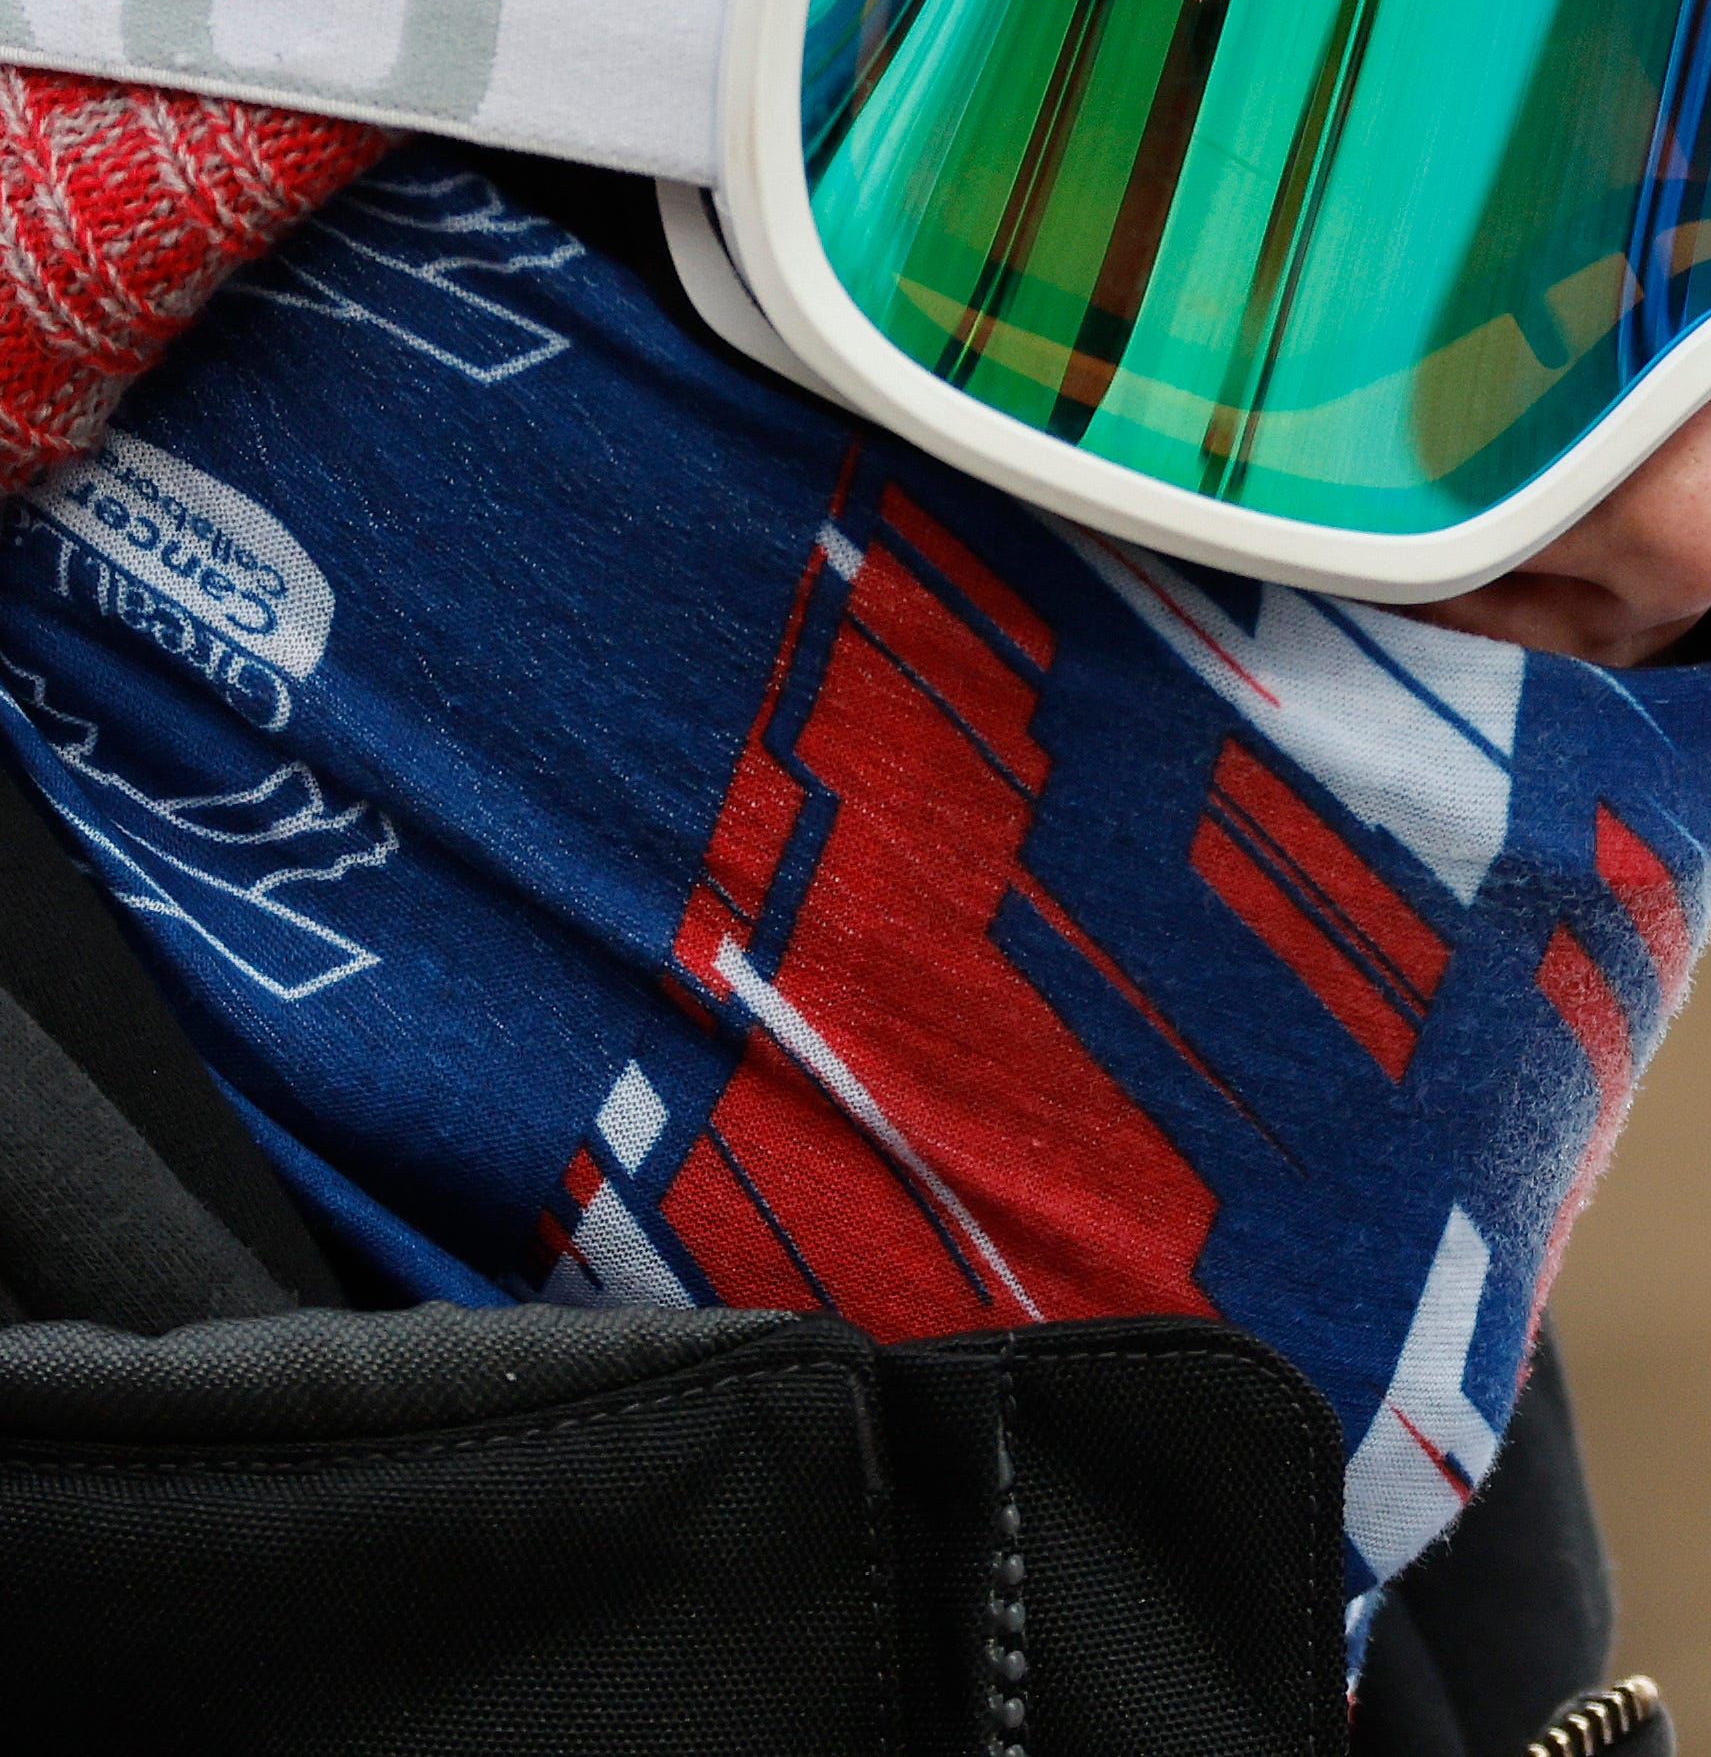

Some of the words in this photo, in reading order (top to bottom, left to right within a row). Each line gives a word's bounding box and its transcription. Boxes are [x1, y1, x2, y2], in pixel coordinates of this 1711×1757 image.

[66, 480, 278, 636] Cancer
[98, 440, 288, 599] Collabora
[86, 558, 292, 732] Great
